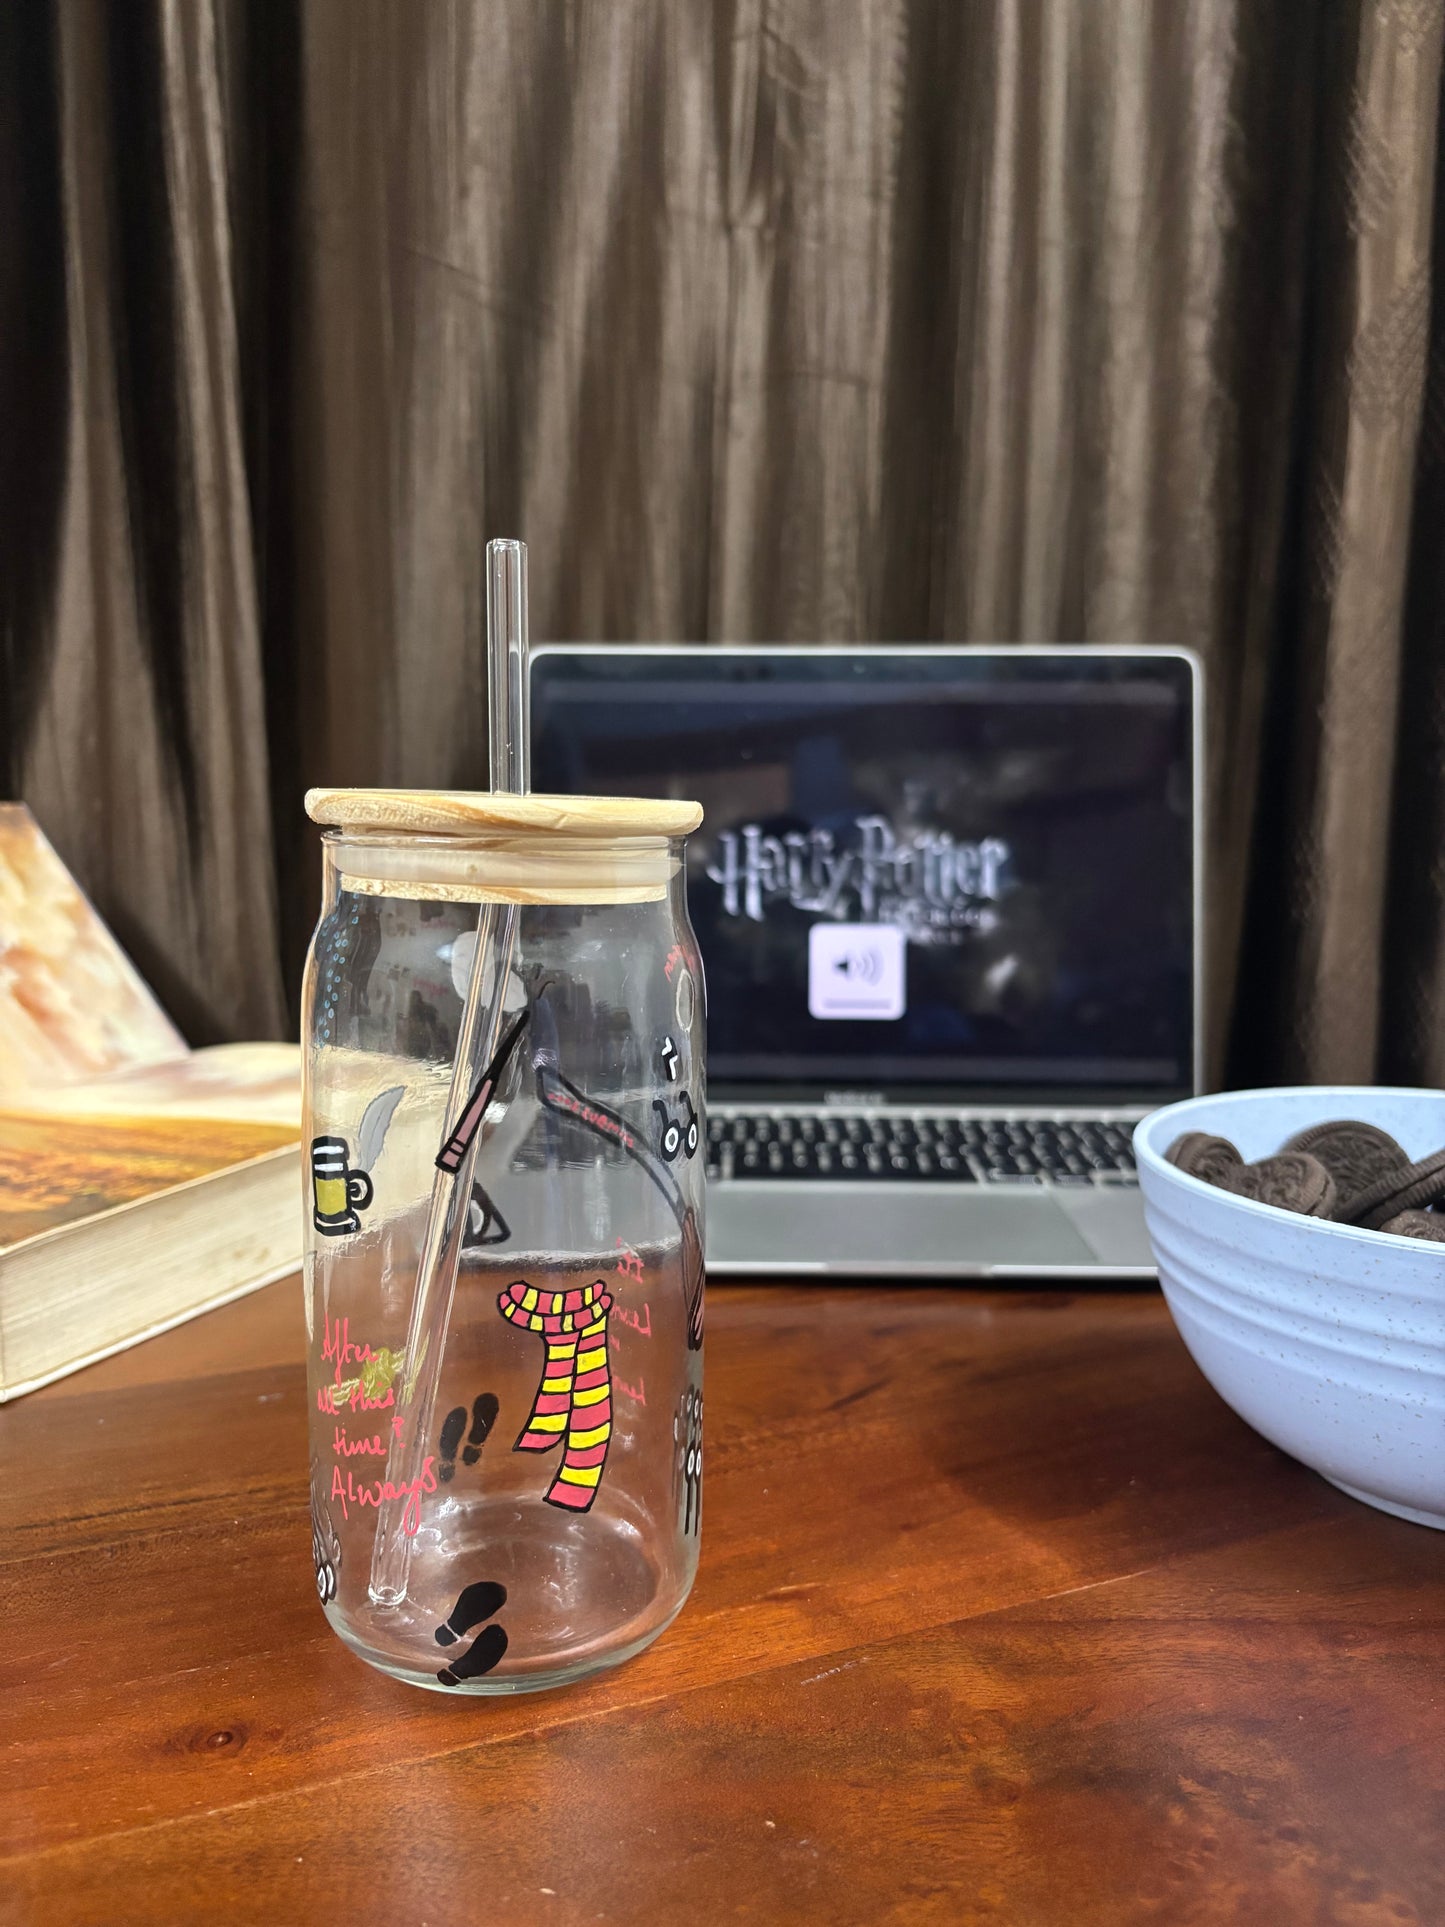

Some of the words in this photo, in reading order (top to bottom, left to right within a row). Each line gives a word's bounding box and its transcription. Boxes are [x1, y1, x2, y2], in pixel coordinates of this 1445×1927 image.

[706, 823, 854, 921] Harry
[855, 814, 1008, 912] Potter
[320, 1309, 379, 1389] After
[349, 1379, 395, 1413] this
[331, 1455, 438, 1537] Always
